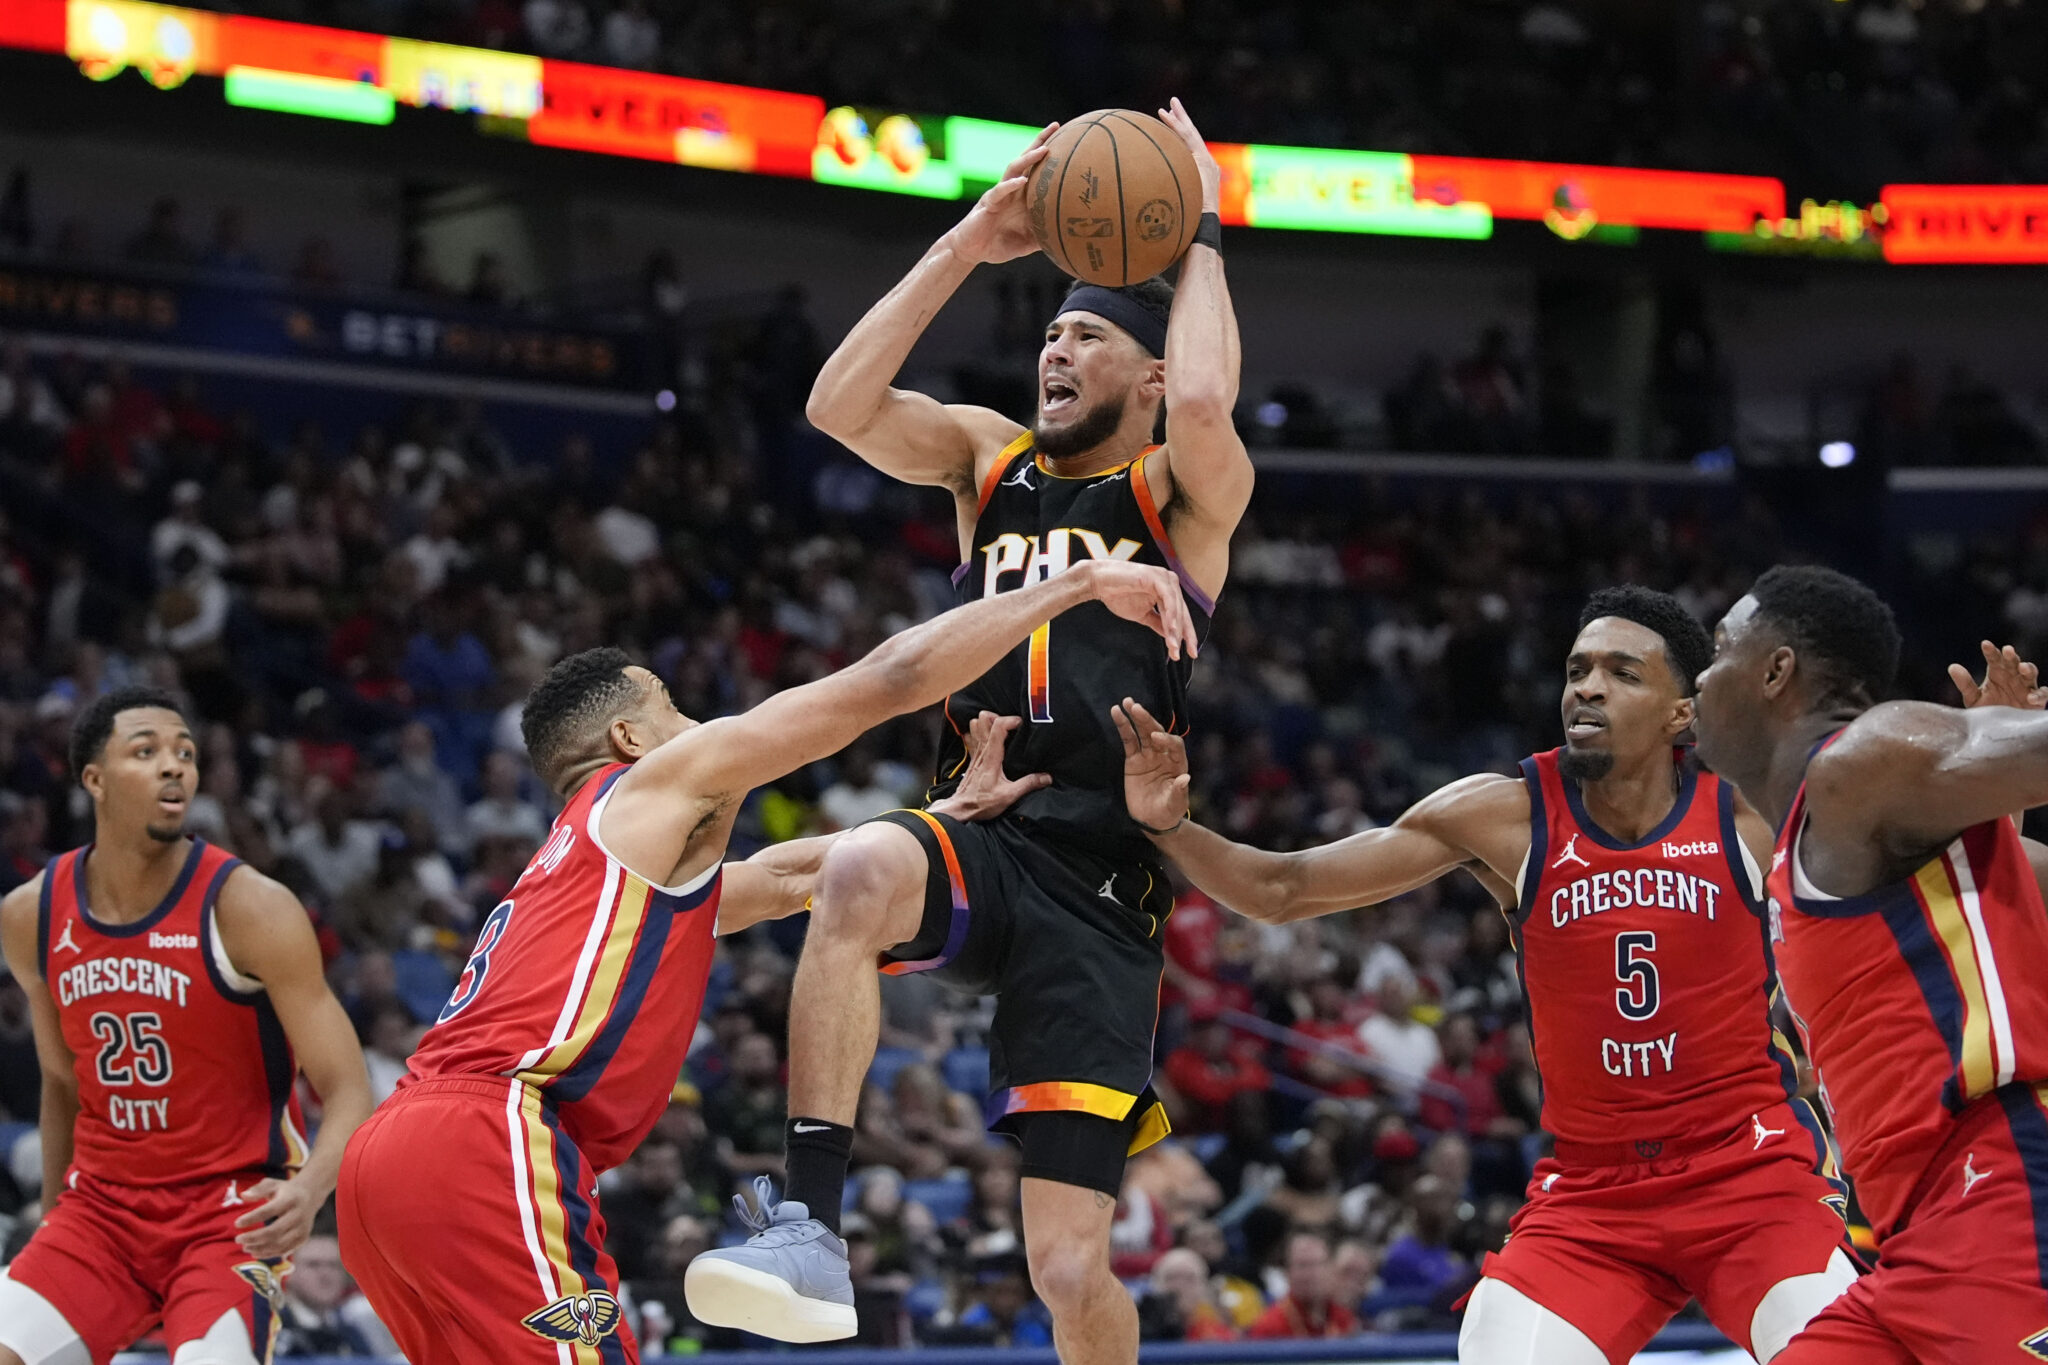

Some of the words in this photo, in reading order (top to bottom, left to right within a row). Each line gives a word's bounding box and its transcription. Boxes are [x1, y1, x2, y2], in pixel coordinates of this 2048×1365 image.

[1028, 620, 1054, 723] 1
[1661, 841, 1719, 858] ibotta
[1551, 868, 1721, 929] CRESCENT
[149, 932, 198, 949] ibotta
[58, 957, 191, 1008] CRESCENT
[1615, 930, 1660, 1022] 5
[90, 1011, 173, 1087] 25
[1601, 1032, 1678, 1078] CITY
[109, 1094, 170, 1132] CITY
